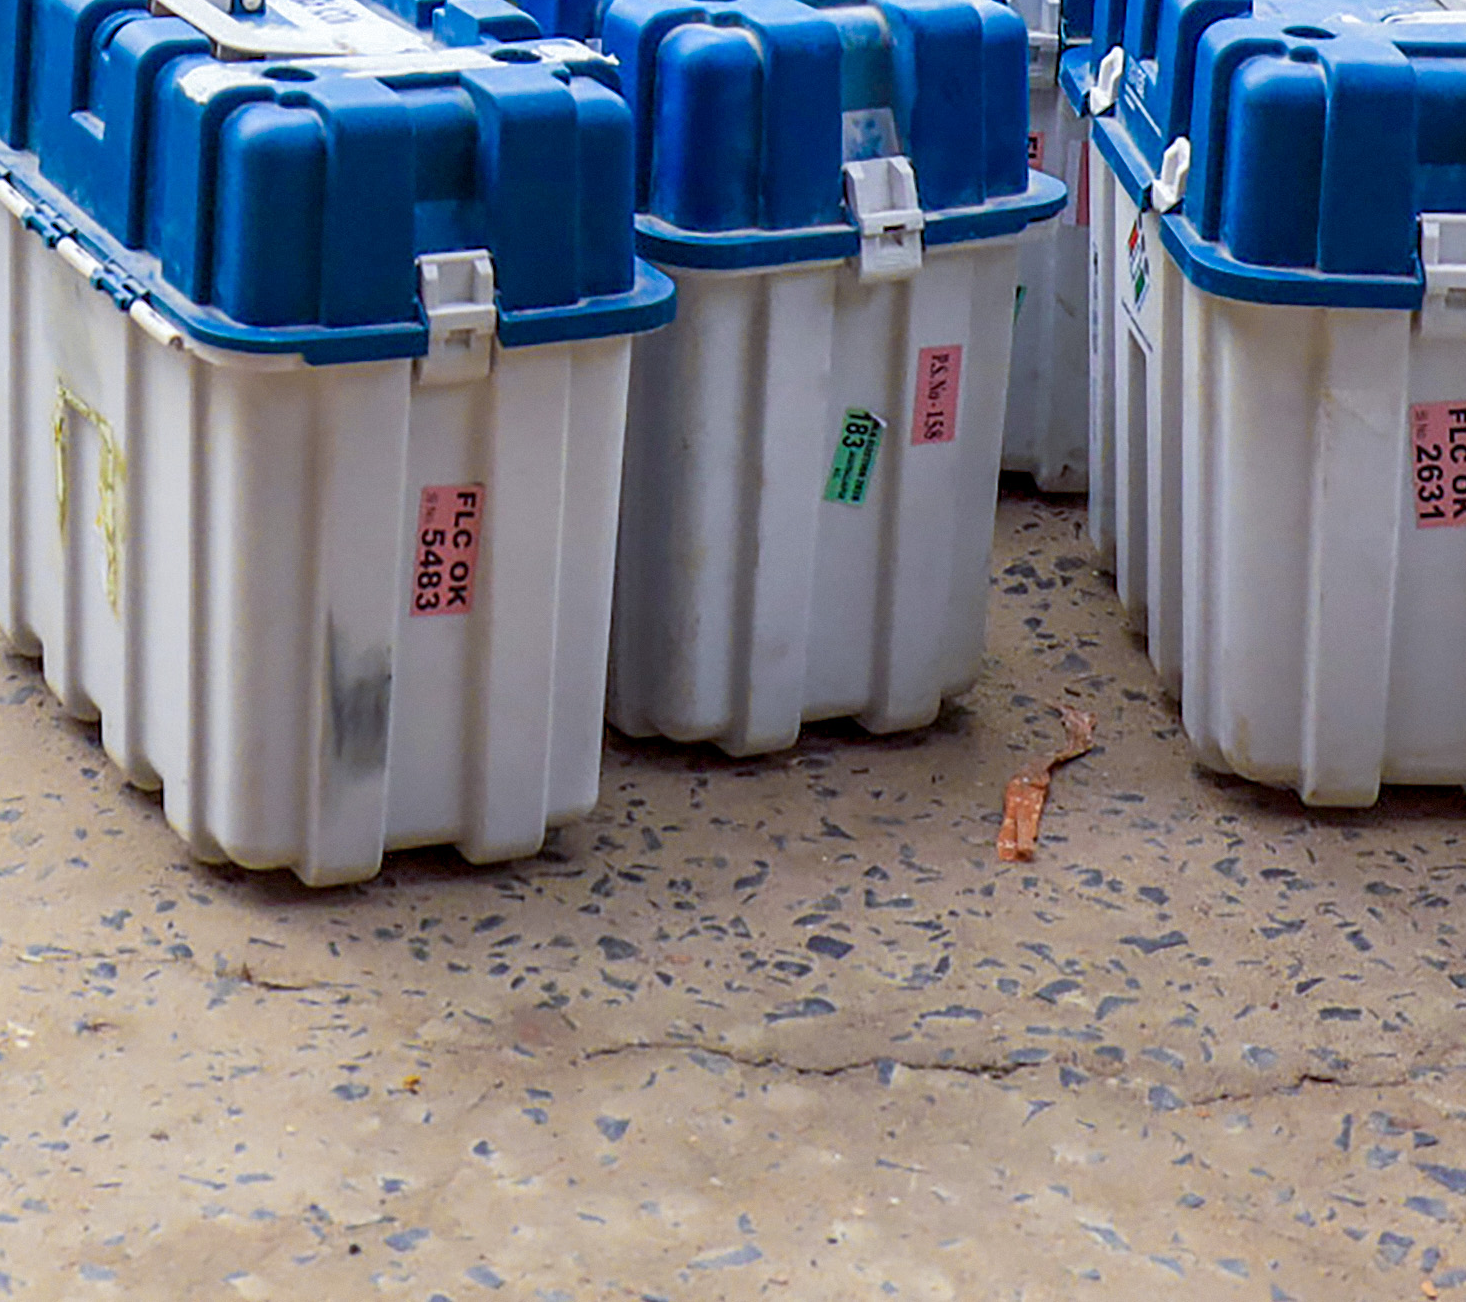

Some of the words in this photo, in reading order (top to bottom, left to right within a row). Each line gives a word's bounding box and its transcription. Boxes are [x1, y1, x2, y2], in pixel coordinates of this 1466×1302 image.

[841, 412, 872, 448] 183
[923, 410, 945, 441] 158
[1416, 443, 1446, 519] 2631
[452, 491, 476, 549] FLC
[414, 528, 446, 611] 5483
[446, 561, 470, 607] OK
